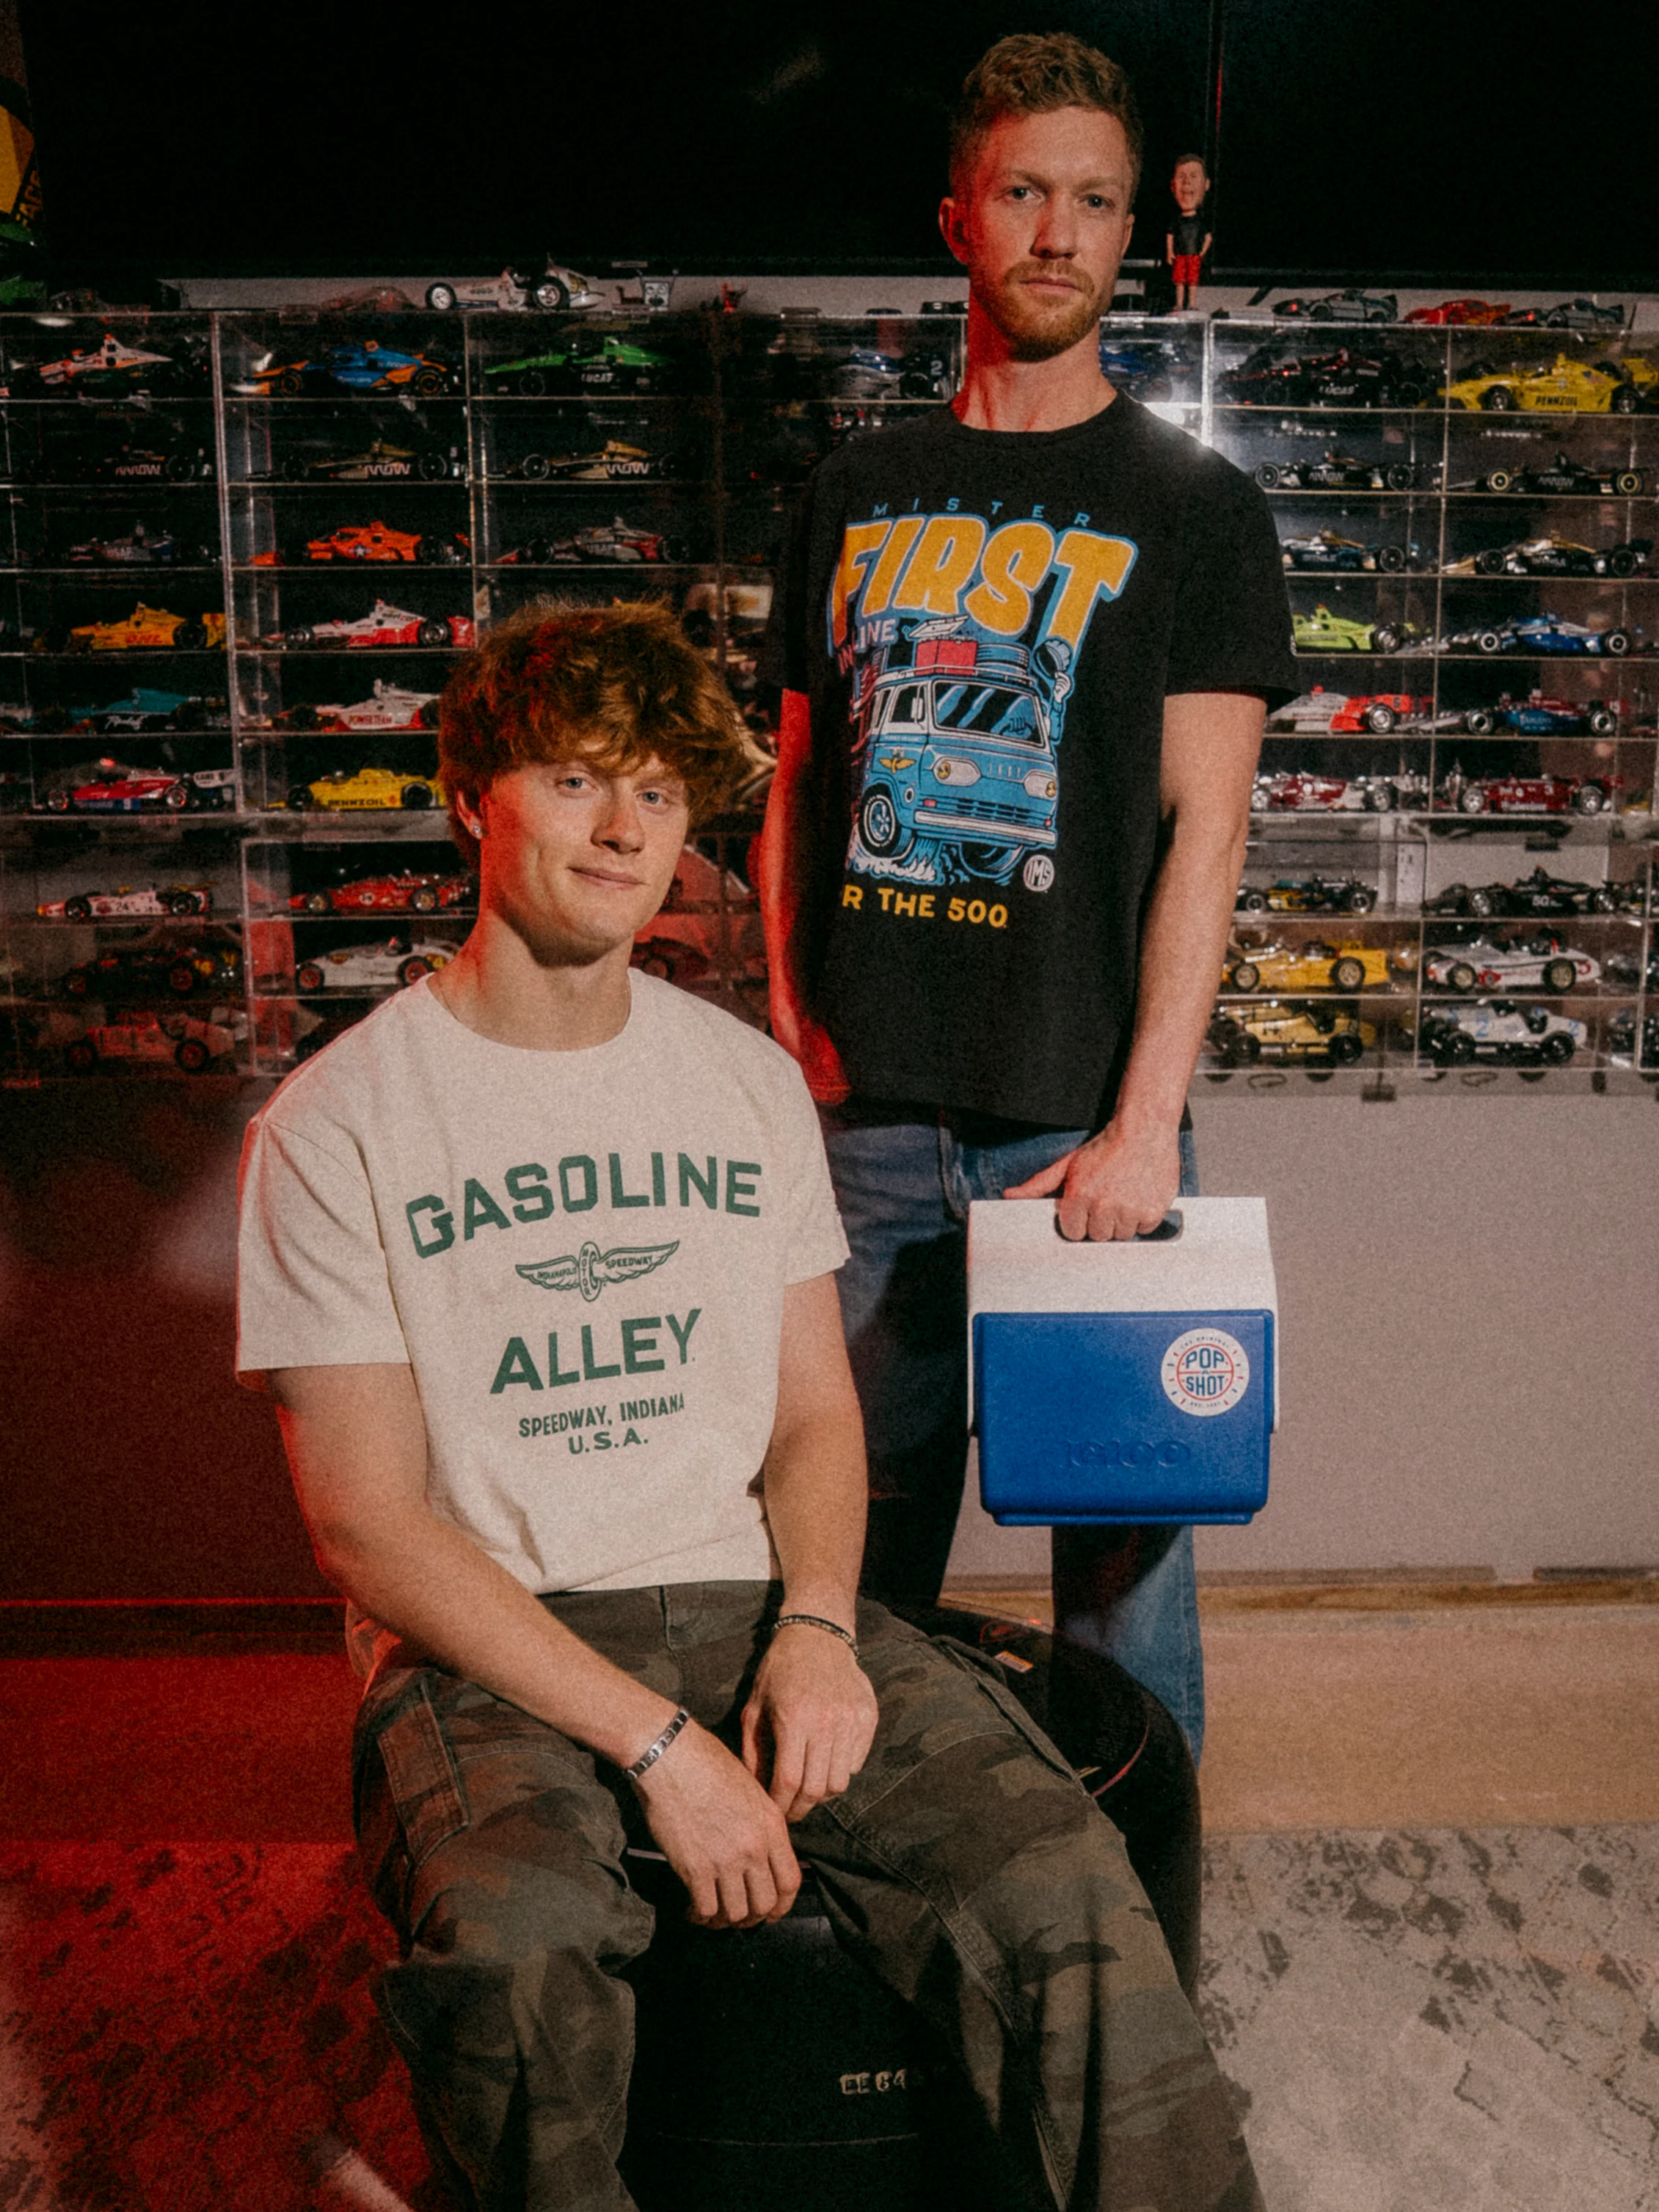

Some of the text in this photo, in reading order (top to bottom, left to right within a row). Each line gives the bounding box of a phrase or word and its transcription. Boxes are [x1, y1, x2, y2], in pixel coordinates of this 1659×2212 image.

[872, 497, 1091, 527] MISTER
[828, 514, 1136, 657] FIRST
[878, 888, 936, 918] THE
[947, 897, 1007, 928] 500
[406, 1152, 762, 1260] GASOLINE
[605, 1255, 653, 1269] SPEEDWAY
[490, 1308, 702, 1394] ALLEY
[1186, 1348, 1225, 1369] POP
[1186, 1376, 1225, 1396] SHOT
[519, 1393, 685, 1438] SPEEDWAY, INDIANA
[568, 1428, 649, 1454] U.S.A.
